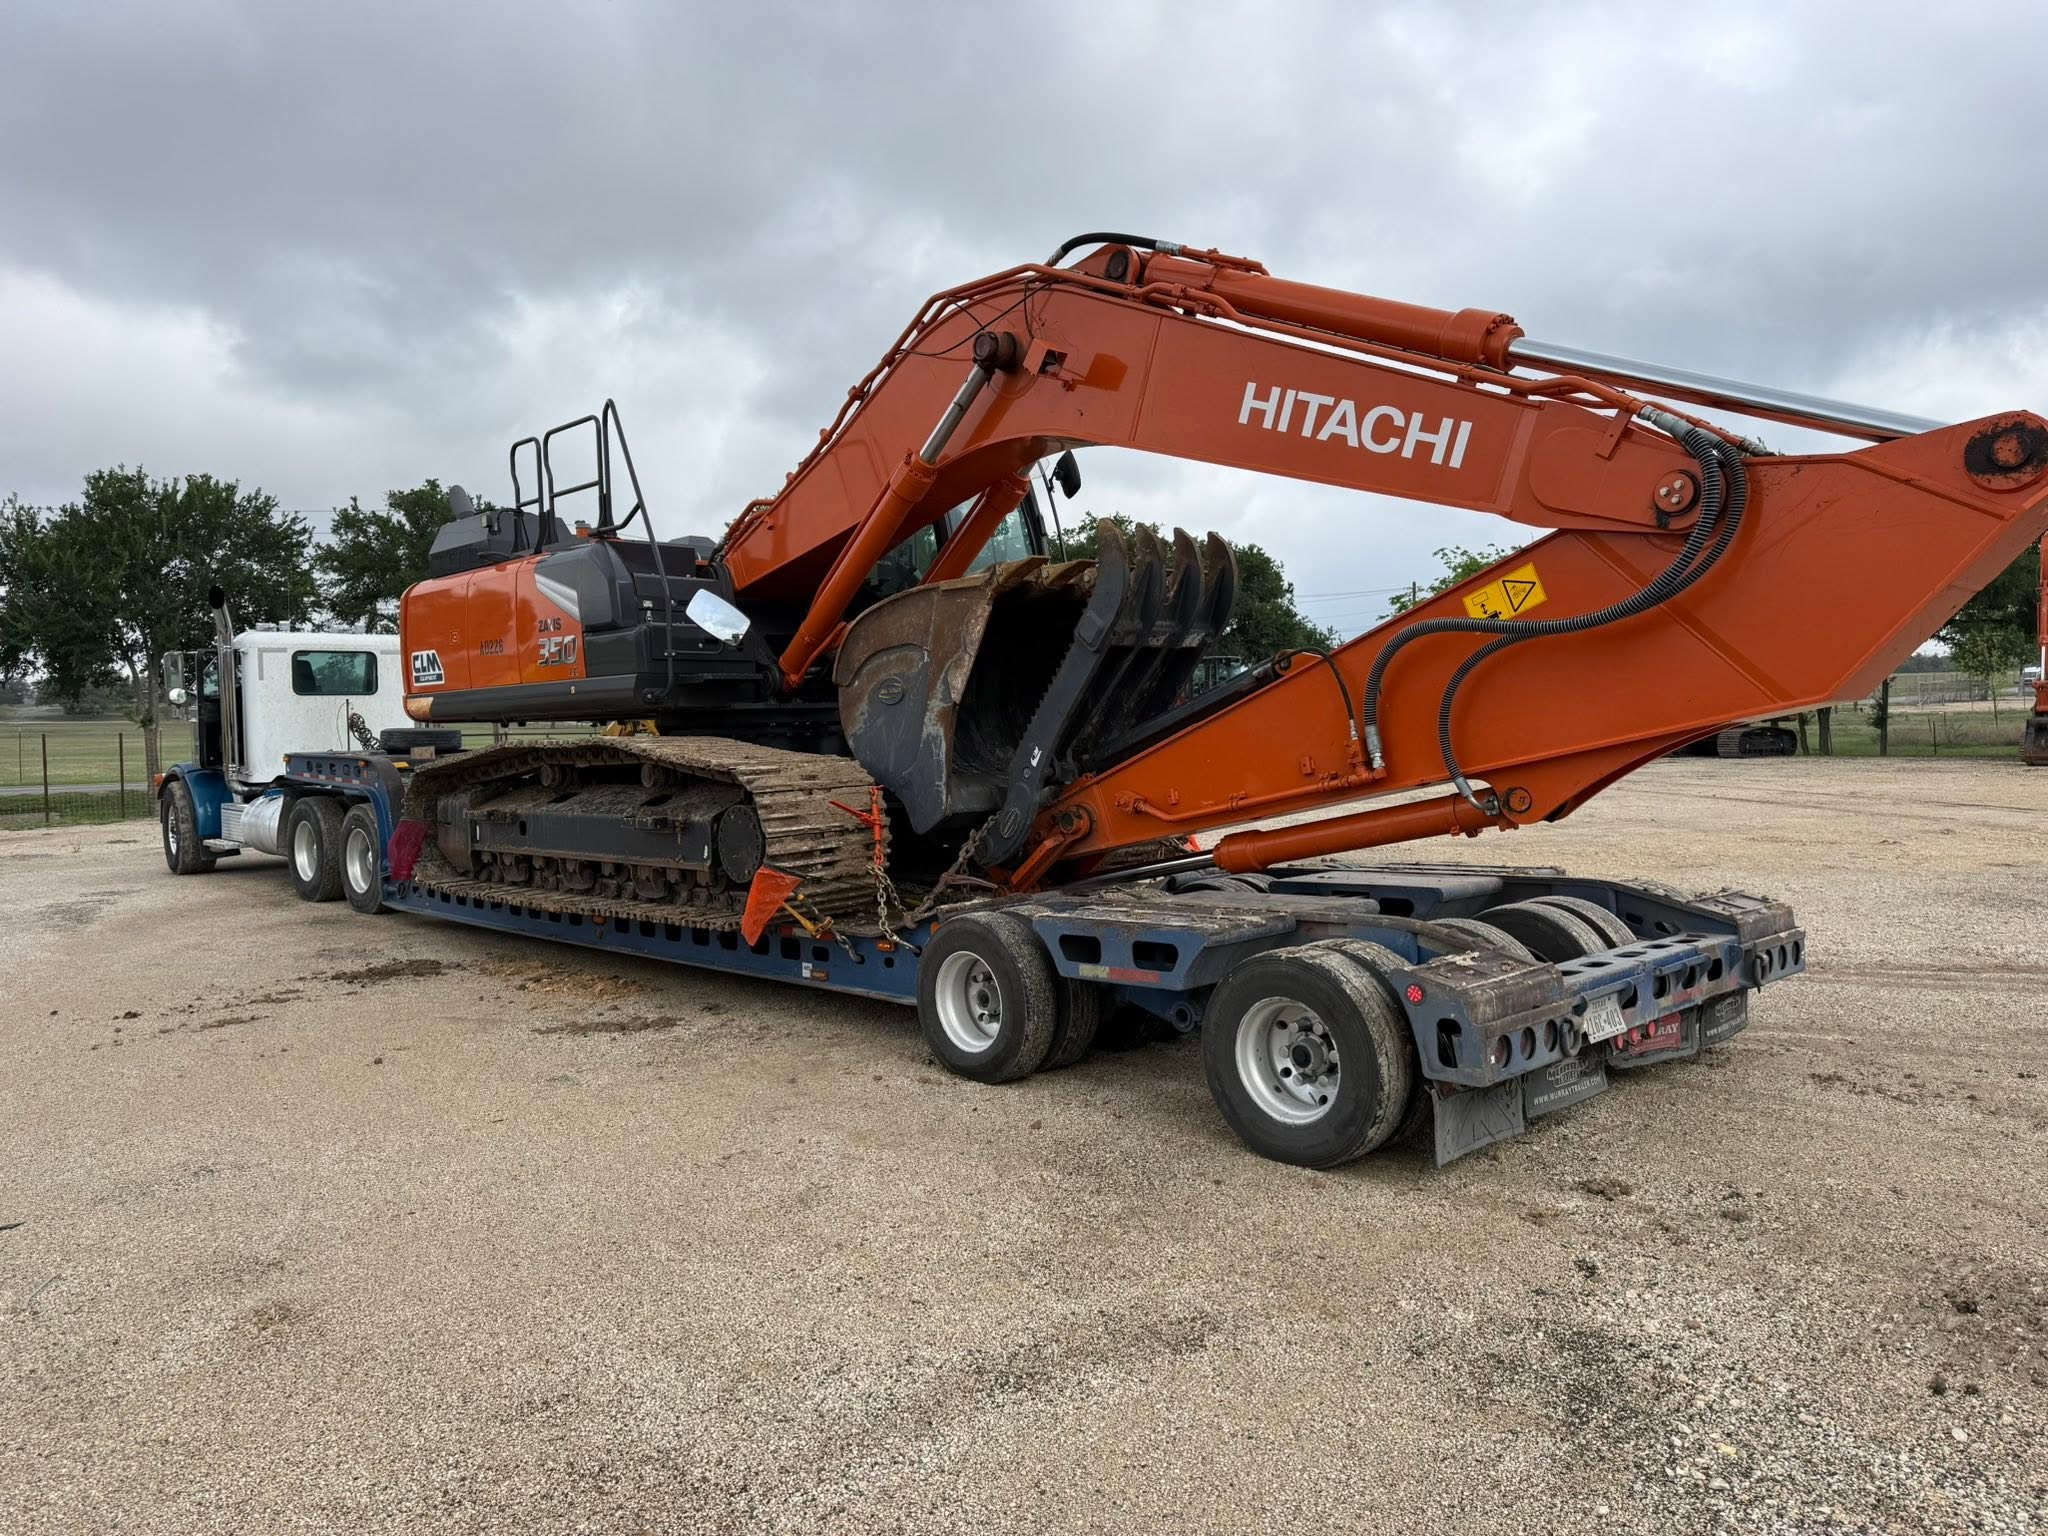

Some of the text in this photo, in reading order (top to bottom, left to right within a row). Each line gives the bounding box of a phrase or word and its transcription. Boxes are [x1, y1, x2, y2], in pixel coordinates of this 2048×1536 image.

[1237, 381, 1473, 470] HITACHI
[412, 652, 442, 674] CLM
[537, 634, 578, 667] 350
